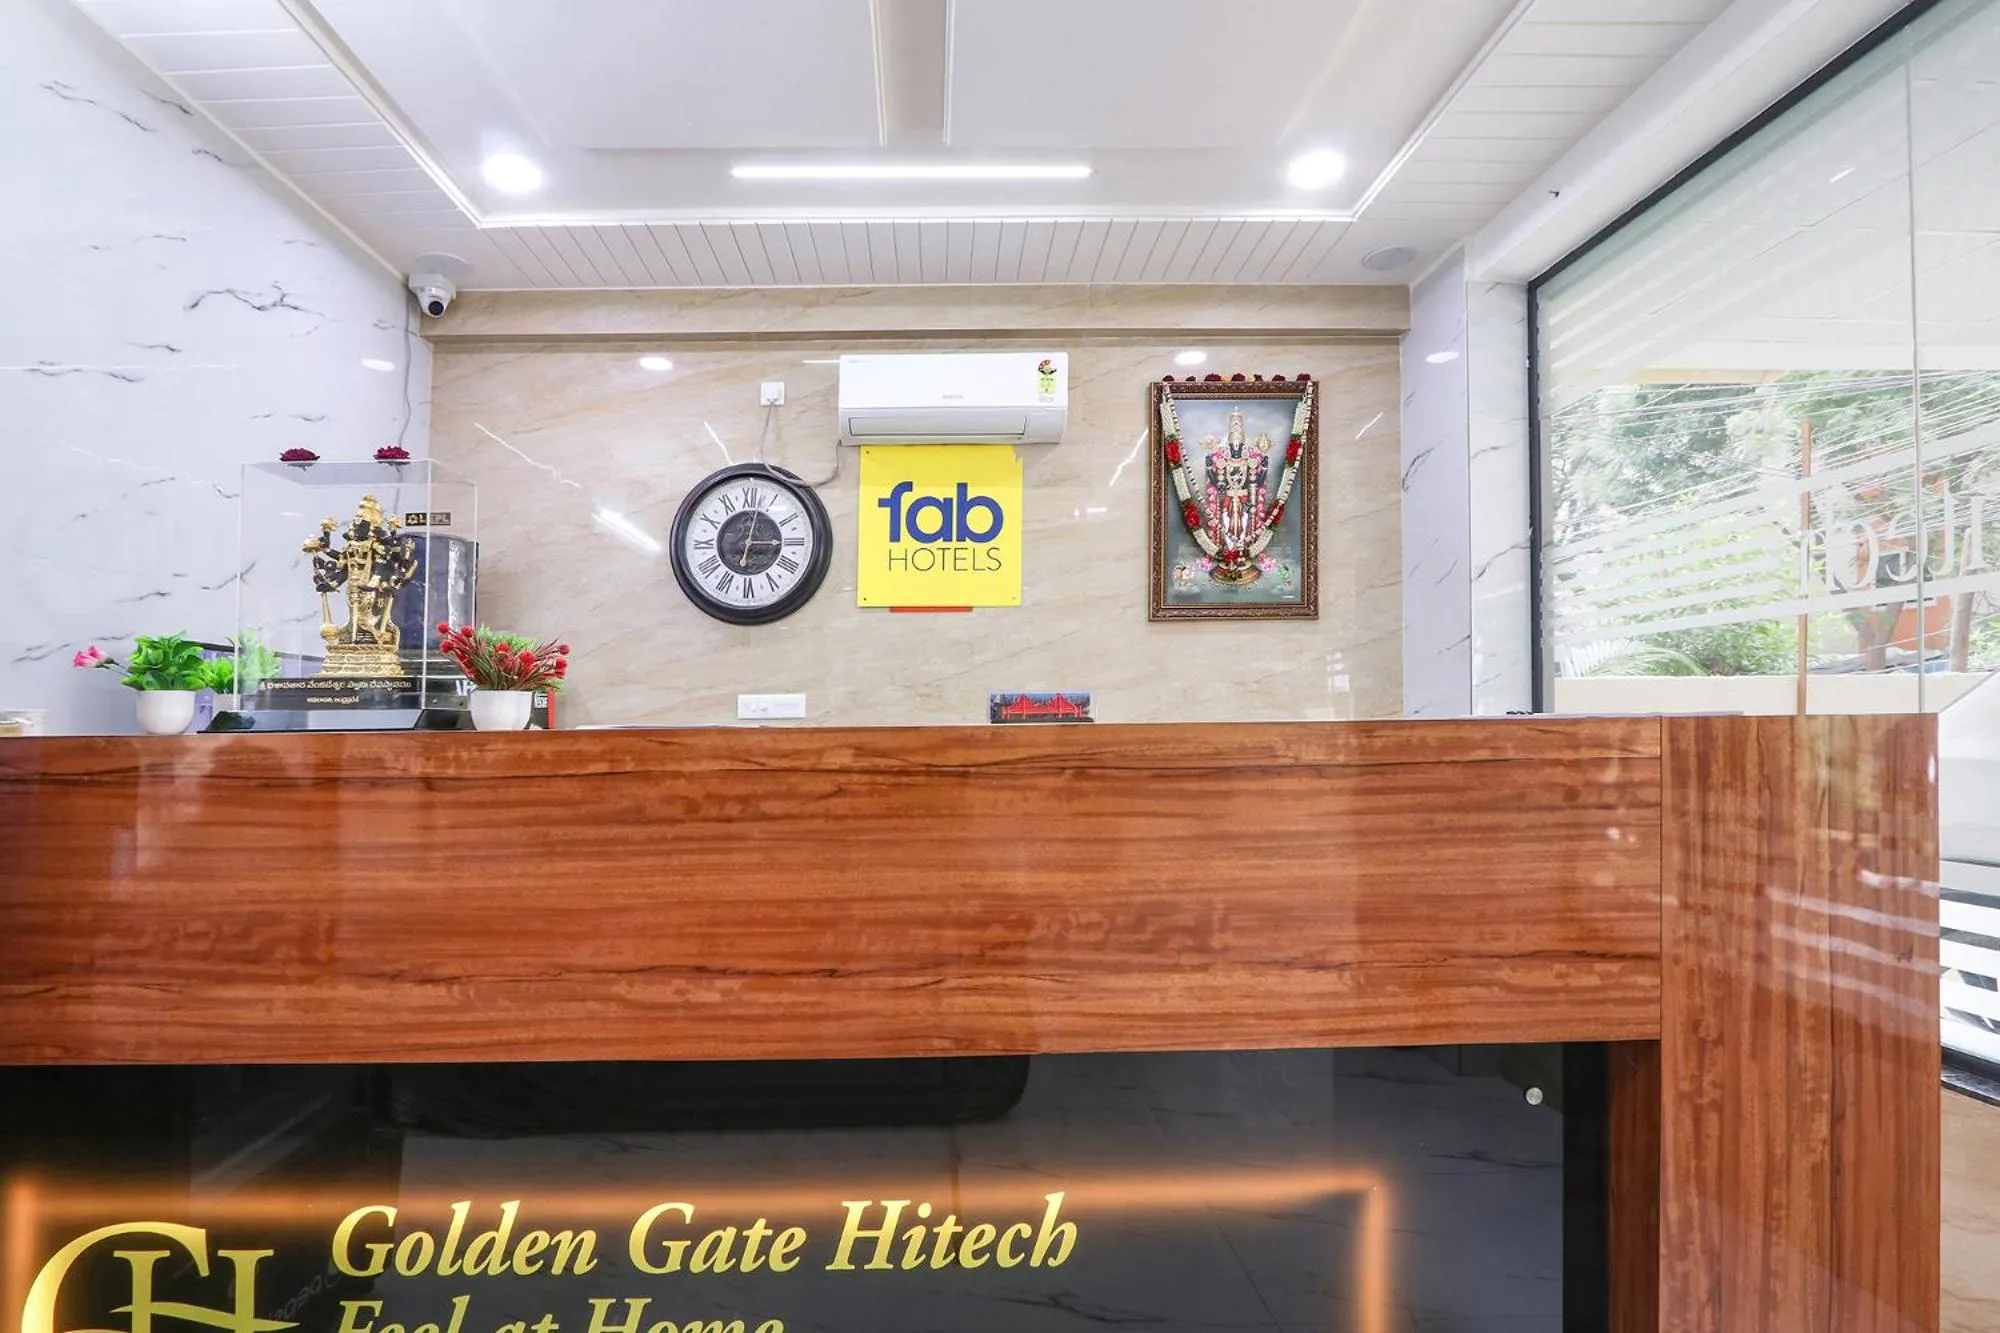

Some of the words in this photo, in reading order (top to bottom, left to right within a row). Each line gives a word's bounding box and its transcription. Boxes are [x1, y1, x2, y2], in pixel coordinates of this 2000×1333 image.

[878, 481, 1004, 543] fab
[889, 547, 1001, 571] HOTELS
[332, 1200, 599, 1277] Golden
[628, 1202, 806, 1274] Gate
[825, 1191, 1078, 1271] Hitech
